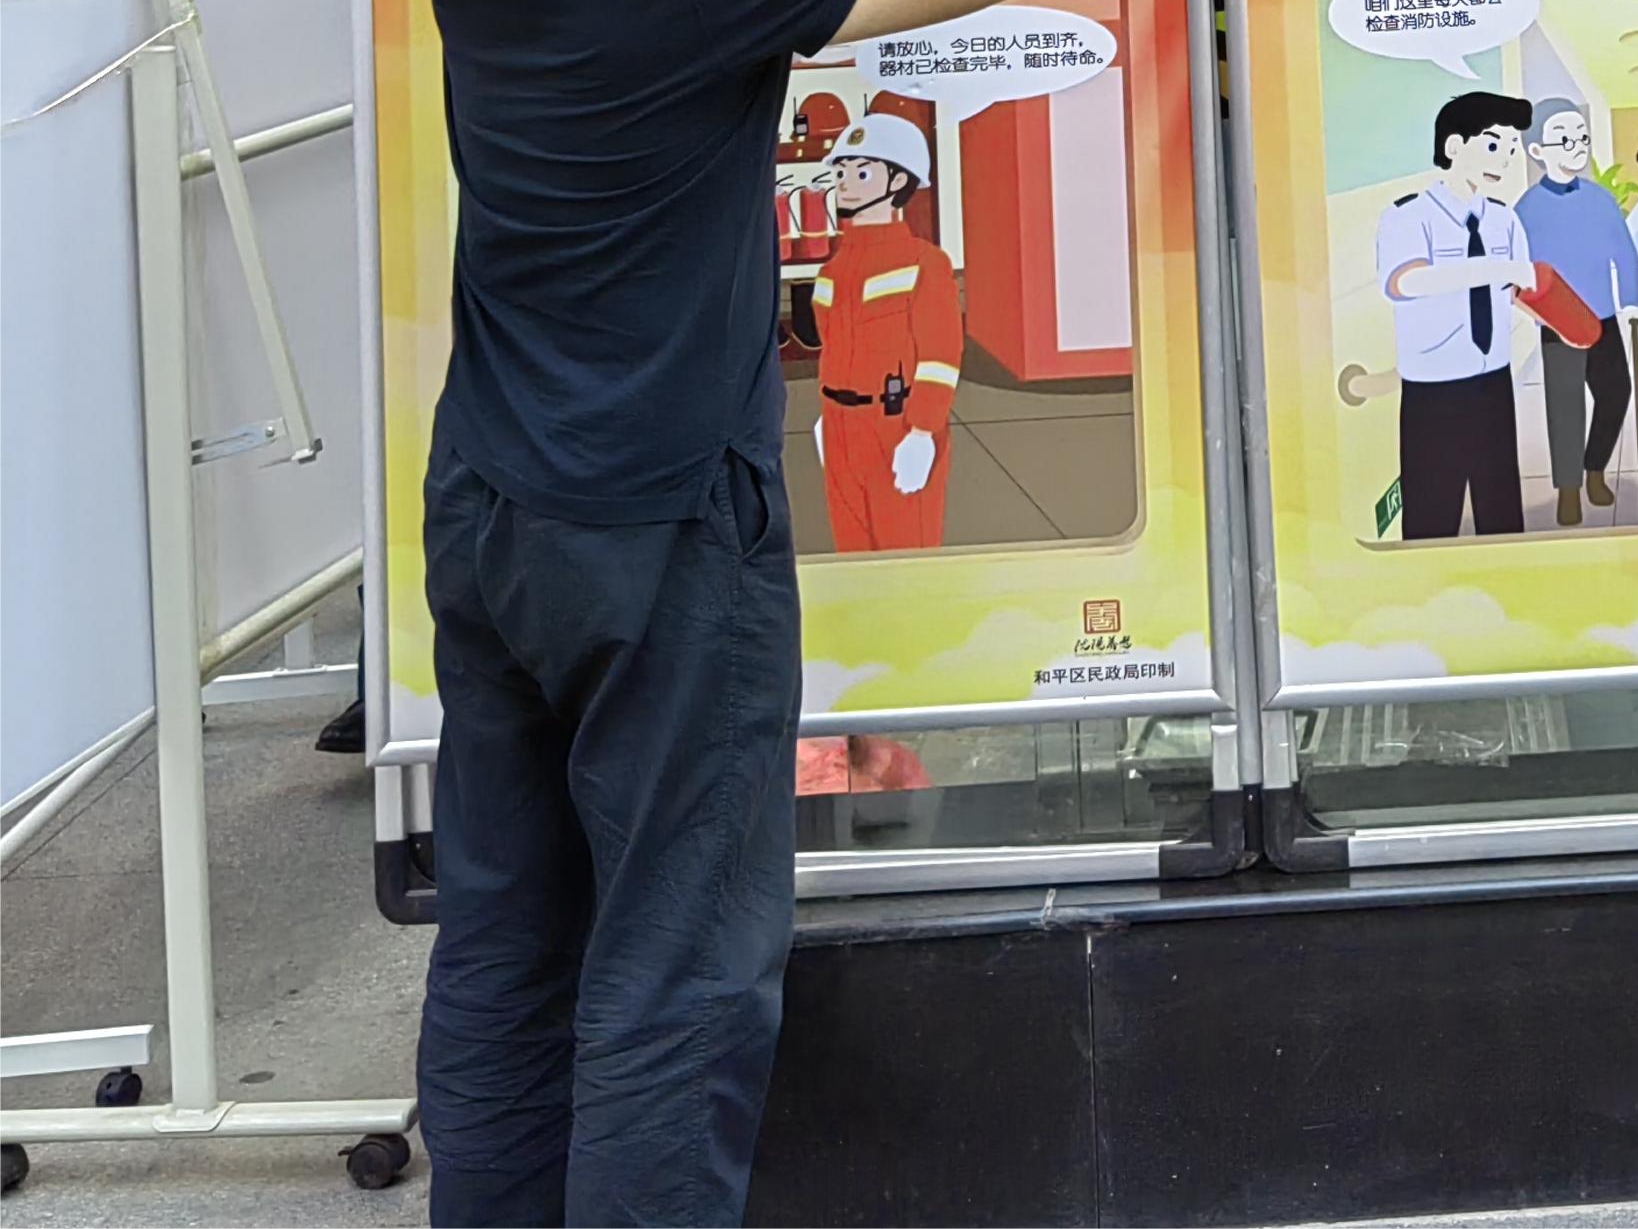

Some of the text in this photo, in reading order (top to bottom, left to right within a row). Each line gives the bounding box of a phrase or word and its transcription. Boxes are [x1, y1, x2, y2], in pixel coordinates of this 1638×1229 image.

[1366, 10, 1480, 32] 检查消防设施。
[879, 49, 1104, 76] 器材已检查完毕，随时待命。
[1033, 661, 1175, 686] 和平区民政局印制
